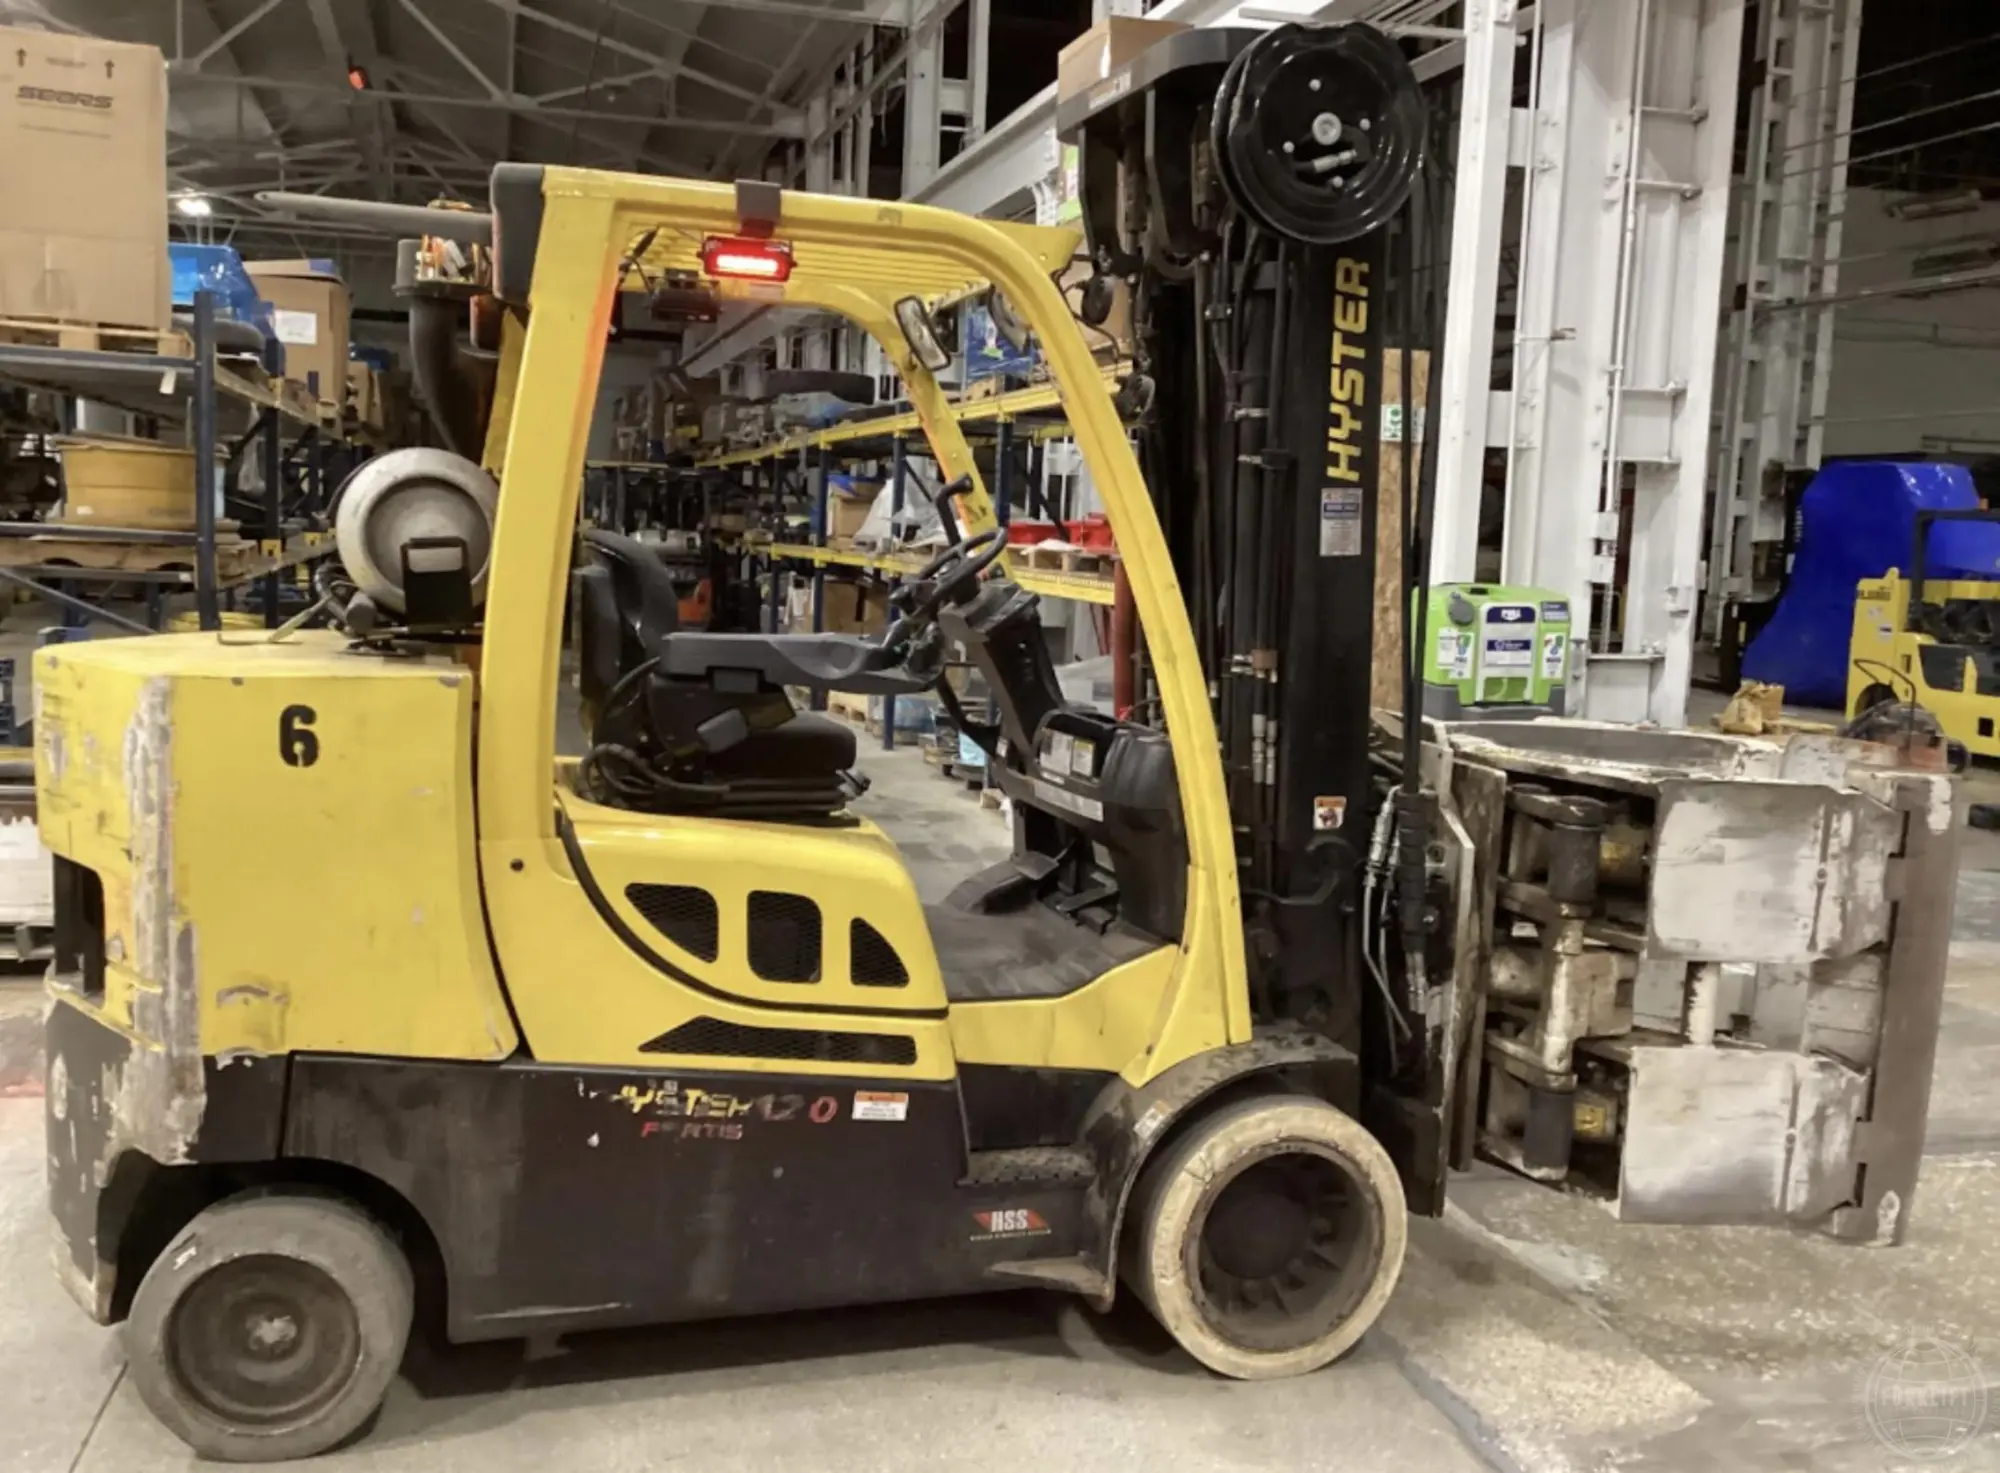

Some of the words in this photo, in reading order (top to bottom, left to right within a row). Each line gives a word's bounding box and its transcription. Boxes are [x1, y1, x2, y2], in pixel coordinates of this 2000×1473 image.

[1327, 257, 1369, 482] HYSTER
[279, 703, 319, 768] 6
[991, 1208, 1028, 1232] HSS
